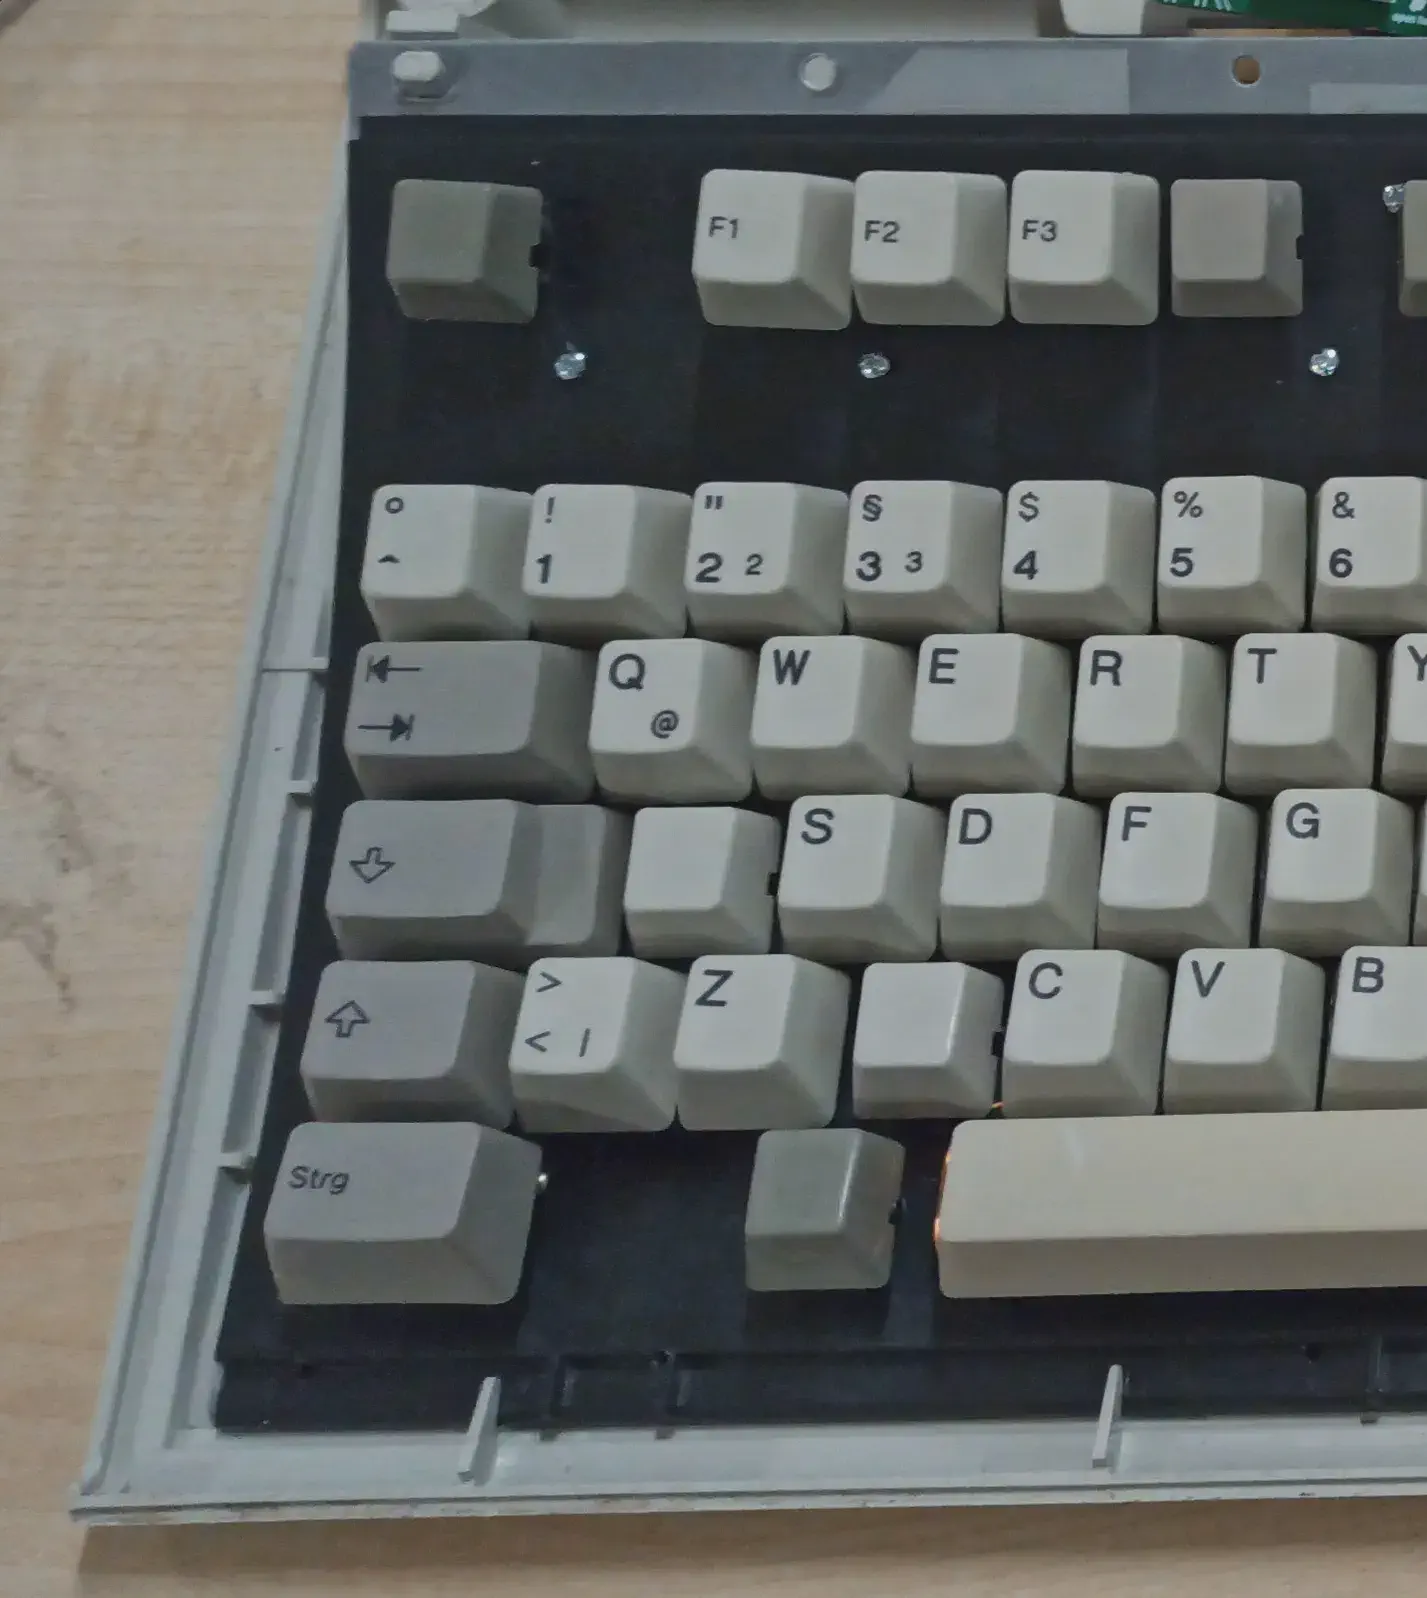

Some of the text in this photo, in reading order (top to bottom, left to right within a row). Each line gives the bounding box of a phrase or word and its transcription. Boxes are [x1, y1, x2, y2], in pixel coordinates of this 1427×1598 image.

[708, 215, 739, 239] F1
[864, 219, 901, 244] F2
[1021, 219, 1058, 243] F3
[862, 493, 883, 523] §
[1018, 491, 1040, 523] $
[1173, 490, 1204, 519] %
[1331, 491, 1355, 519] &
[536, 553, 553, 585] 1
[695, 551, 764, 584] 2 2
[855, 550, 923, 582] 3 3
[1012, 550, 1039, 581] 4
[1169, 547, 1194, 578] 5
[1328, 547, 1354, 579] 6
[608, 653, 646, 691] Q
[772, 648, 811, 686] W
[928, 647, 960, 685] E
[1089, 649, 1123, 687] R
[1246, 647, 1278, 685] T
[650, 709, 680, 740] @
[800, 807, 835, 845] S
[958, 807, 993, 845] D
[1121, 805, 1153, 842] F
[1285, 801, 1320, 840] G
[536, 971, 563, 993] >
[694, 968, 734, 1007] Z
[1028, 961, 1064, 1000] C
[1190, 959, 1226, 998] V
[1351, 956, 1385, 994] B
[524, 1030, 551, 1053] <
[289, 1165, 350, 1196] Strg
